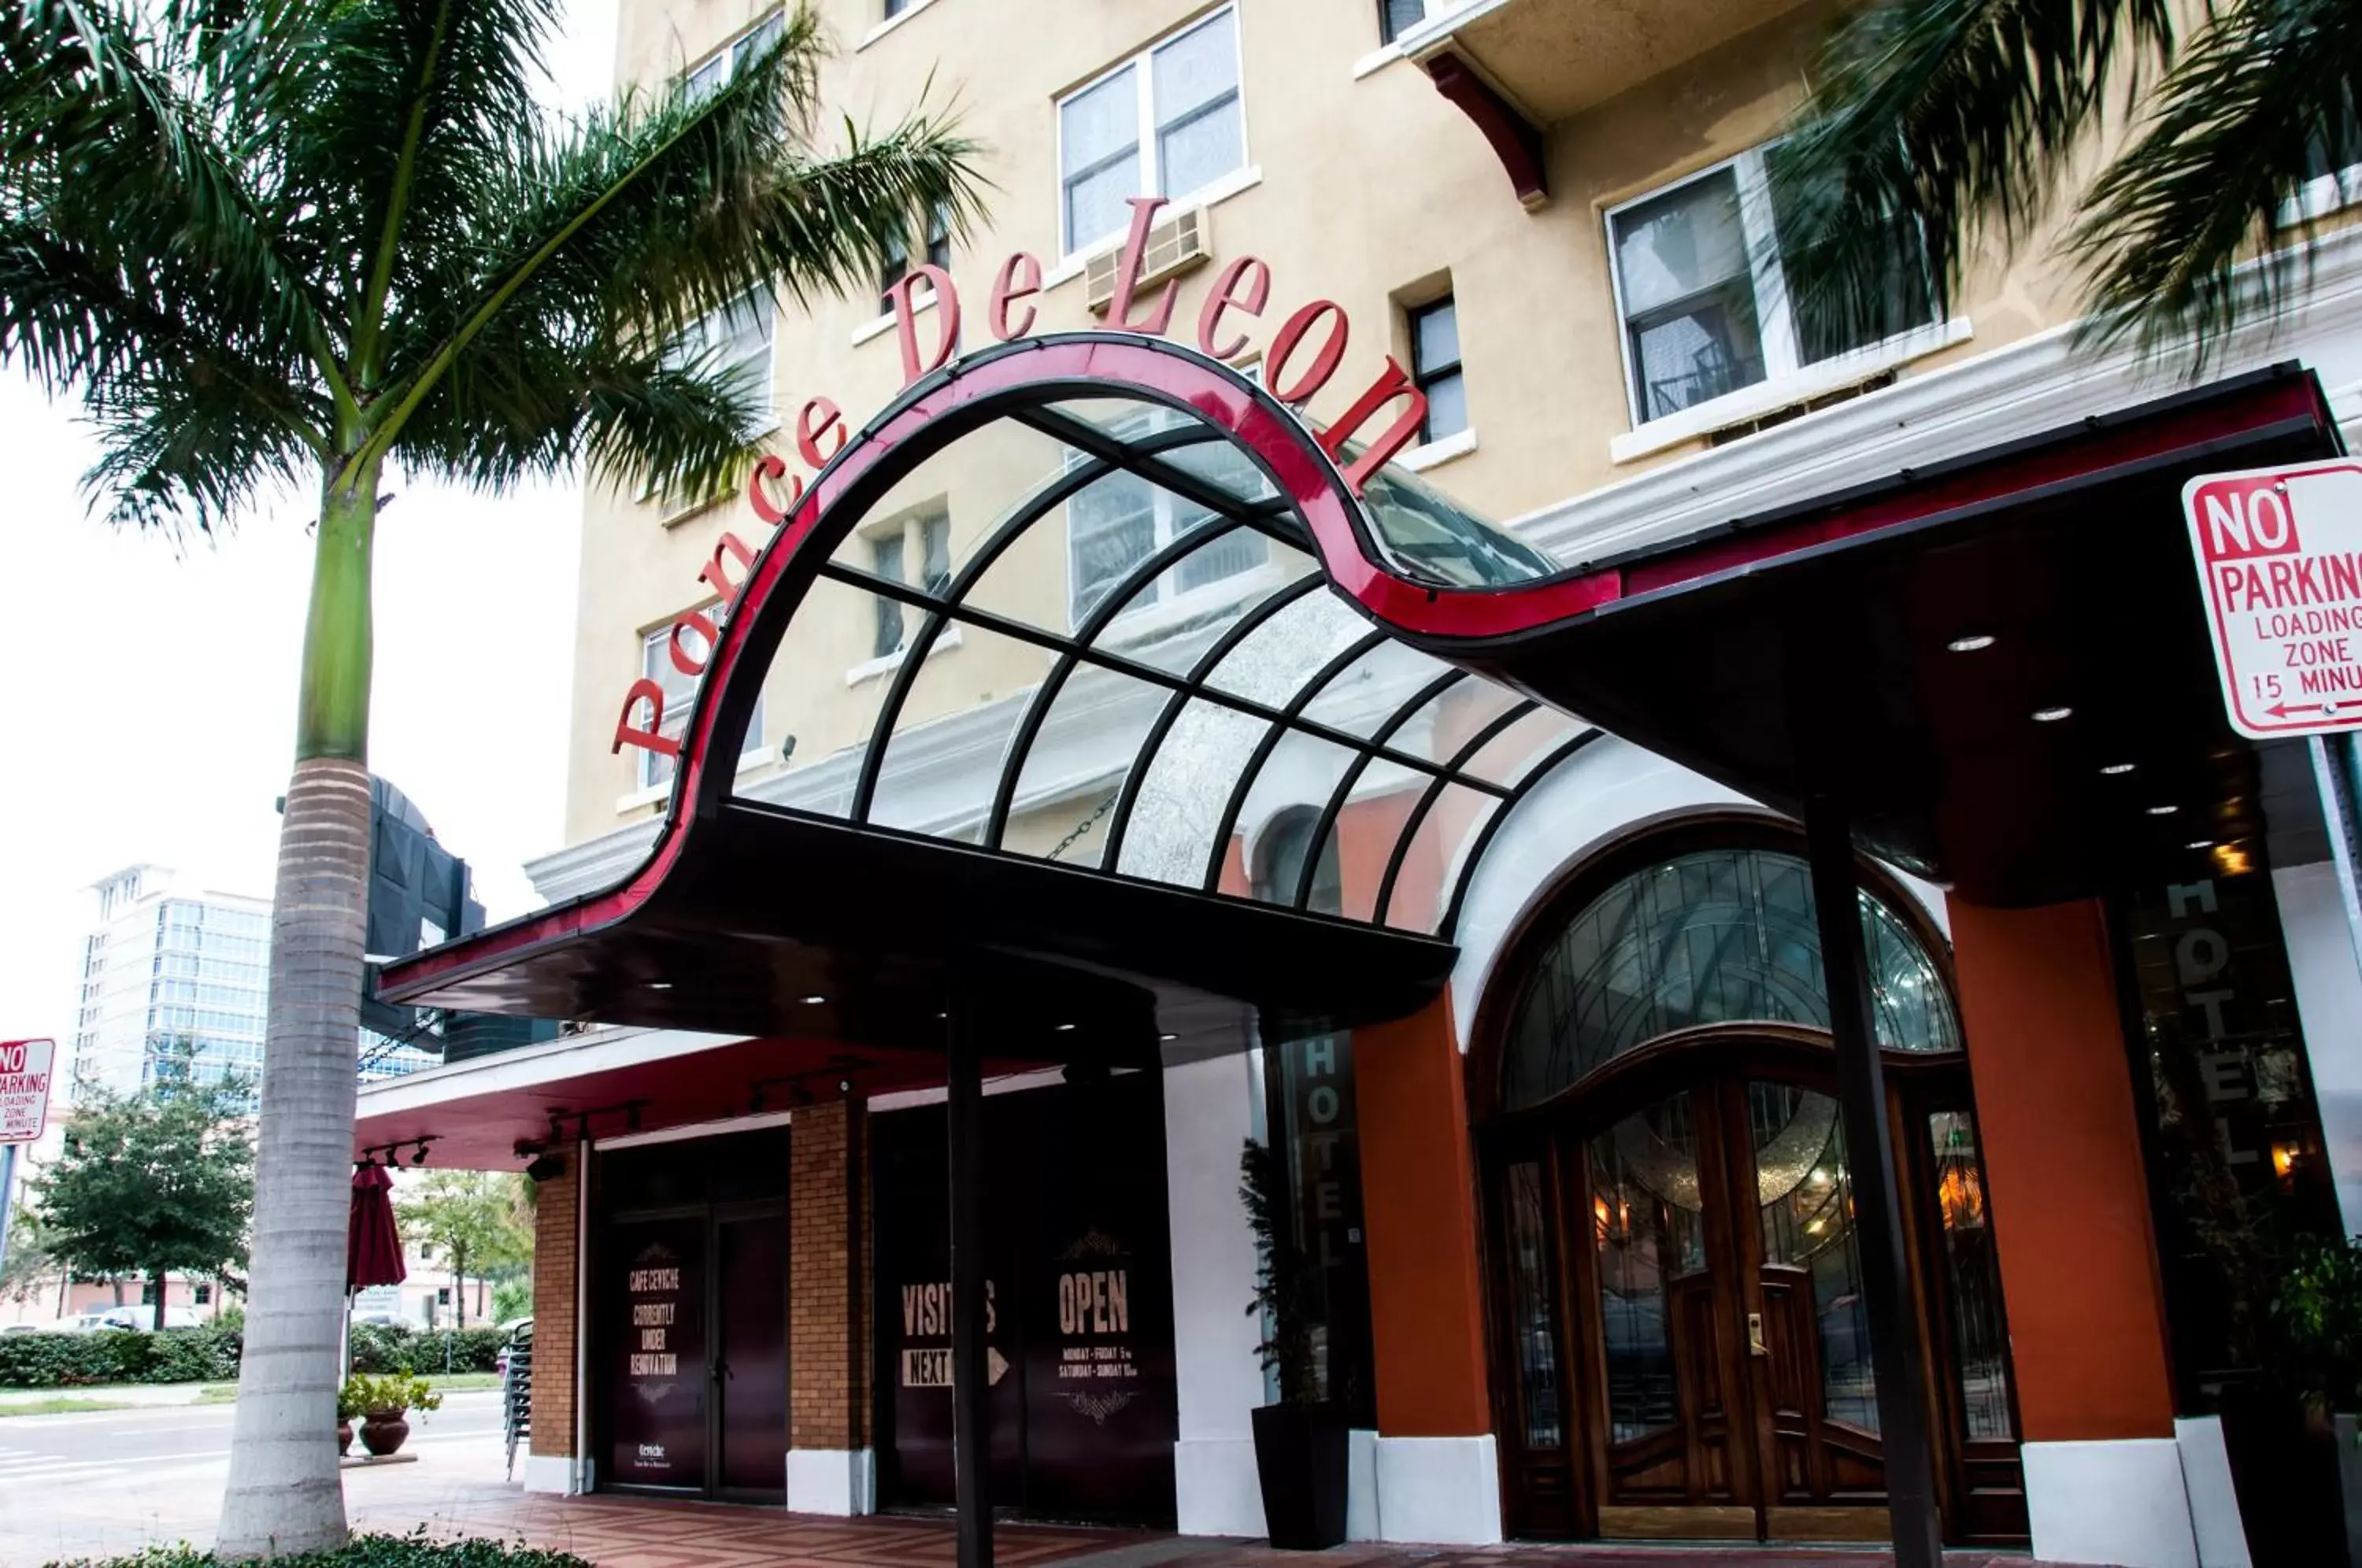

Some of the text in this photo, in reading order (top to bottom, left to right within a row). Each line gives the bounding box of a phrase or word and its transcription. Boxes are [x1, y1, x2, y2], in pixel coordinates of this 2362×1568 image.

[612, 198, 1427, 767] Ponce De Leon
[2204, 487, 2290, 555] NO
[2219, 552, 2362, 612] PARKIN
[2255, 605, 2362, 640] LOADING
[2283, 638, 2353, 668] ZONE
[2253, 674, 2282, 699] 15
[2167, 878, 2260, 1165] HOTEL
[0, 1045, 25, 1072] NO
[0, 1073, 46, 1095] ARKING
[4, 1108, 26, 1119] ZONE
[6, 1118, 38, 1129] MINUTE
[1305, 1037, 1346, 1269] HOTEL
[630, 1269, 647, 1291] CAFE
[633, 1303, 675, 1326] CURRENTLY
[1059, 1270, 1128, 1334] OPEN
[641, 1328, 666, 1350] UNDER
[630, 1353, 677, 1375] RENOVATION
[910, 1351, 947, 1384] NEXT
